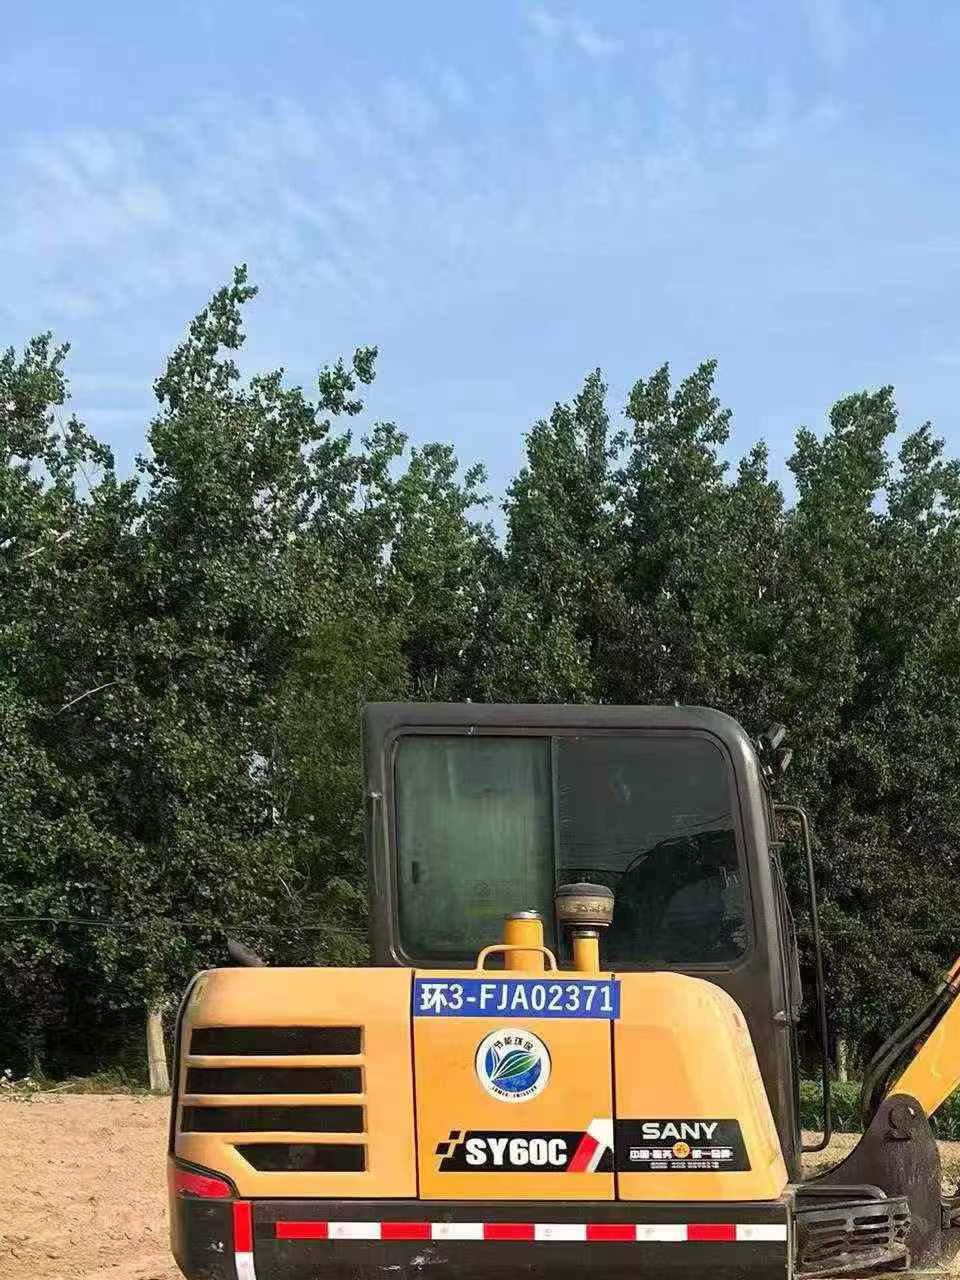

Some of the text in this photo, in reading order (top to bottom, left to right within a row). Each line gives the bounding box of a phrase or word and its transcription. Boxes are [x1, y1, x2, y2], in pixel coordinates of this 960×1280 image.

[420, 983, 613, 1013] 环3-FJA02371
[641, 1122, 718, 1140] SANY
[465, 1138, 568, 1166] SY60C
